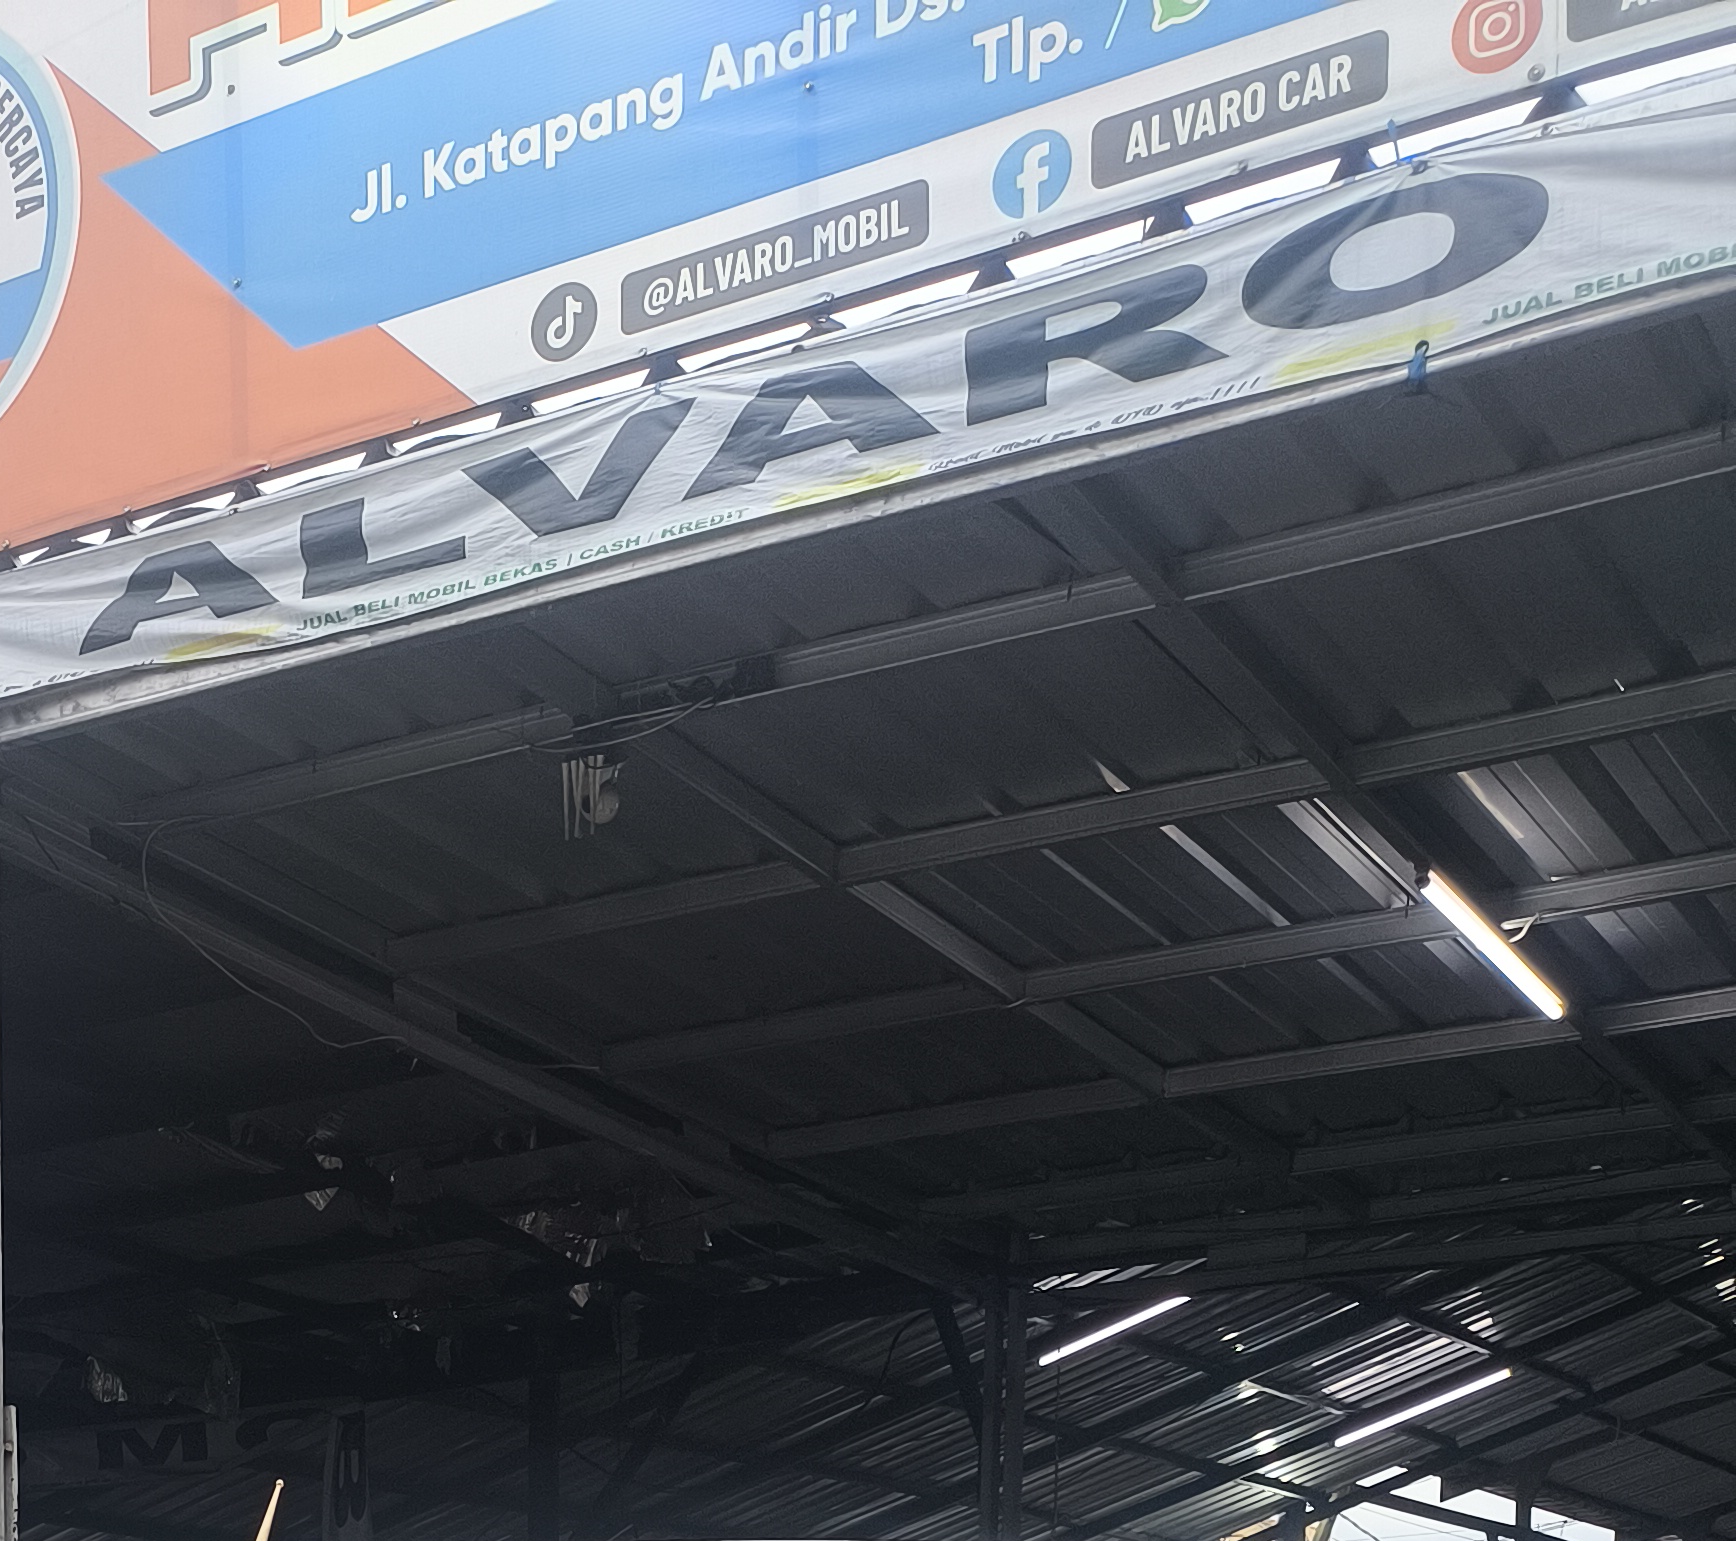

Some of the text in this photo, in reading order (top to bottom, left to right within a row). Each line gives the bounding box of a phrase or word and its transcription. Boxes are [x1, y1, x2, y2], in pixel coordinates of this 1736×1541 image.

[972, 15, 1083, 83] Tlp.
[350, 162, 408, 223] Jl.
[423, 72, 684, 198] Katapang
[699, 4, 857, 101] Andir
[1124, 54, 1353, 164] ALVARO CAR
[643, 199, 910, 316] @ALVARO_MOBIL
[1481, 291, 1563, 325] JUAL
[1574, 267, 1644, 300] BELI
[78, 172, 1550, 655] ALVARO
[296, 609, 348, 632] JUAL
[354, 595, 400, 617] BELI
[408, 578, 477, 606] MOBIL
[483, 557, 558, 588] BEKAS
[579, 535, 642, 562] CASH
